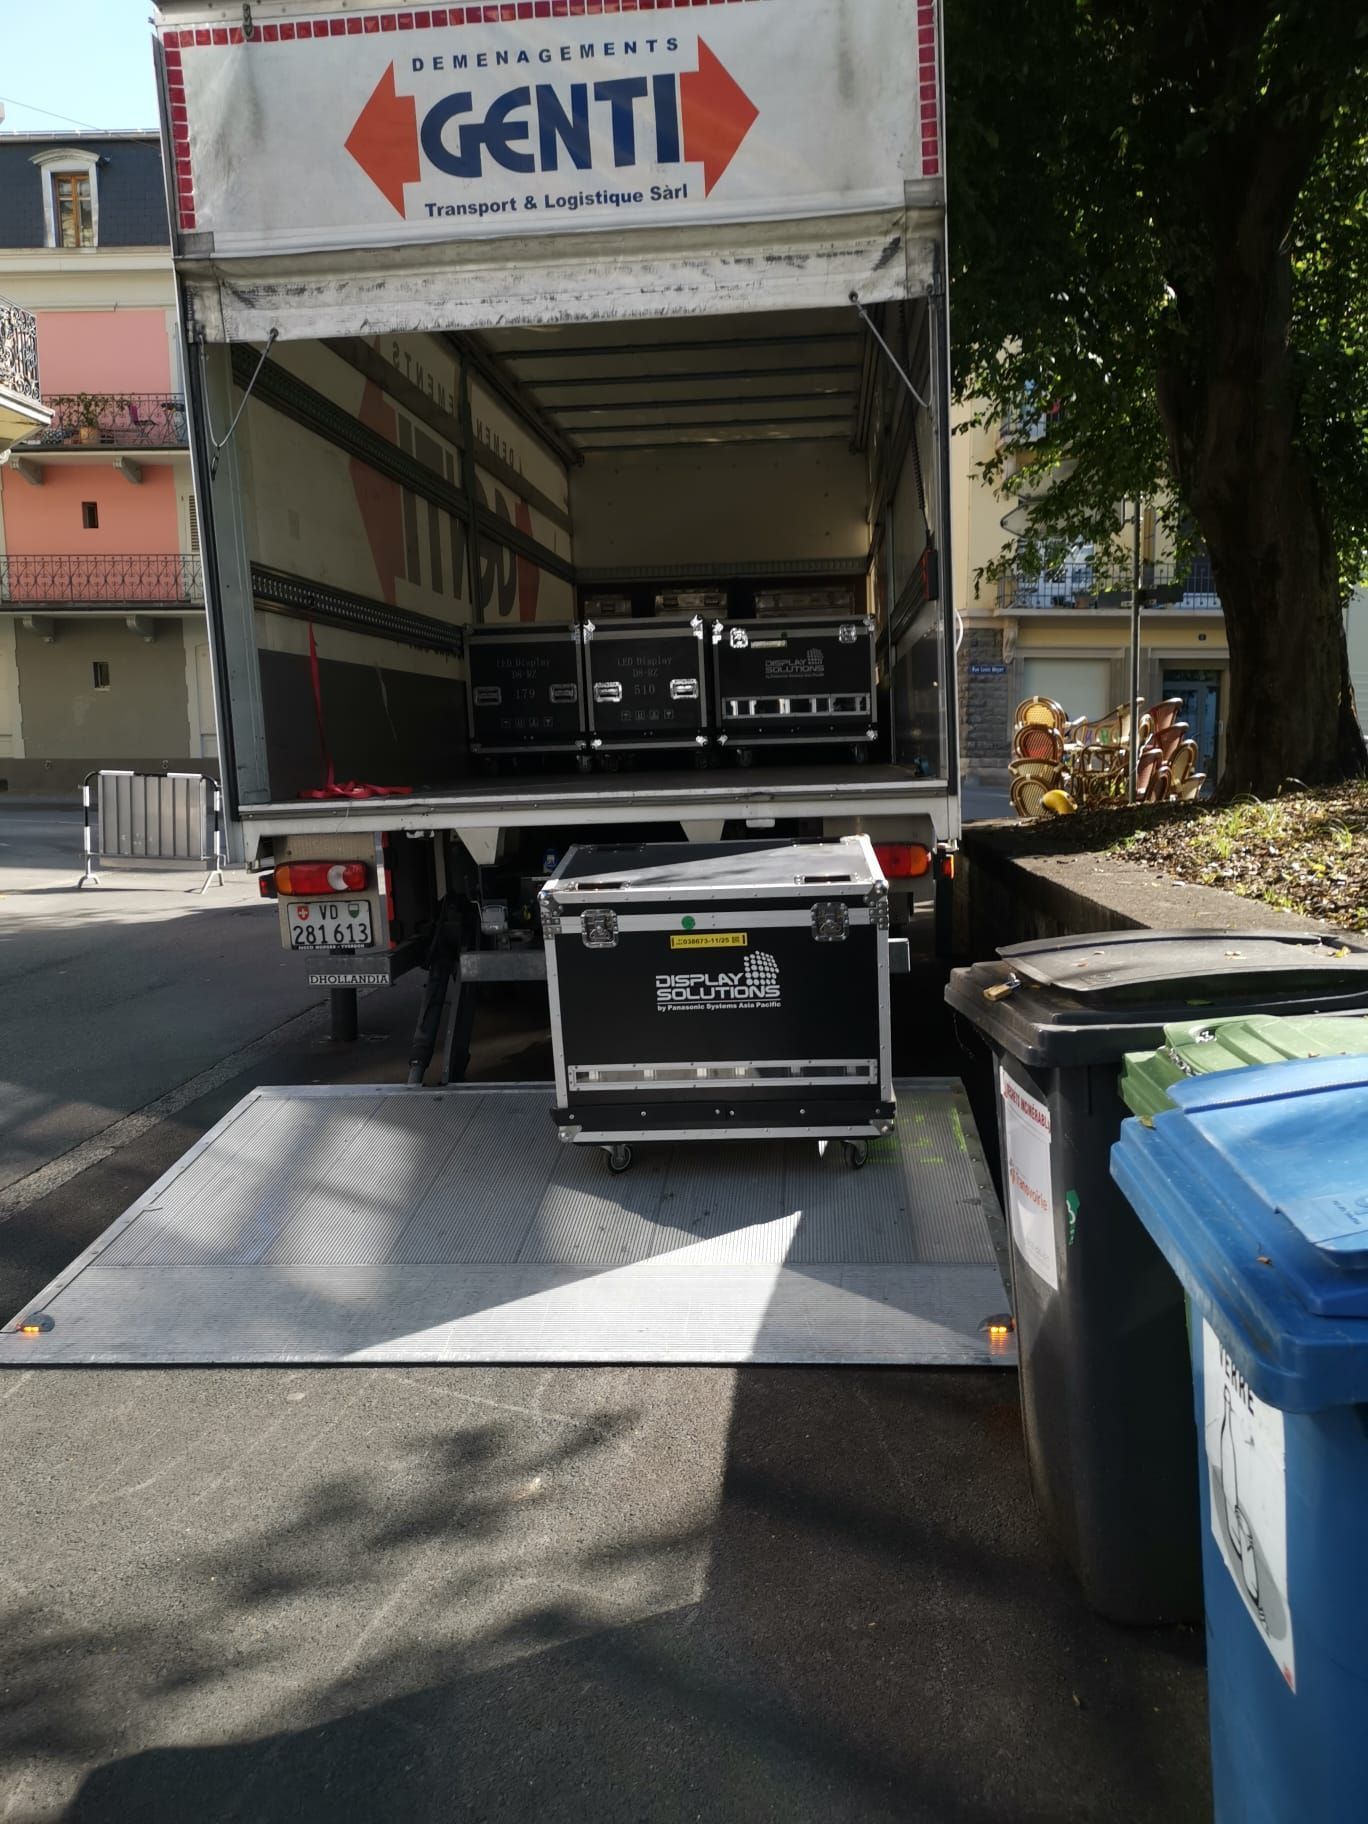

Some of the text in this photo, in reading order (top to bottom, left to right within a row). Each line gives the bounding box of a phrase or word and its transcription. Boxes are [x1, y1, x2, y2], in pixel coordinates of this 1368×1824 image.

[412, 37, 679, 73] DEMENAGEMENTS
[420, 73, 680, 178] GENTI
[425, 183, 688, 218] Transport & Logistique Sàrl
[765, 658, 807, 667] DISPLAY
[765, 665, 825, 674] SOLUTIONS
[634, 683, 656, 696] 510
[319, 904, 338, 920] VD
[310, 974, 388, 985] DHOLLANDIA
[655, 972, 744, 988] DISPLAY
[656, 985, 781, 1001] SOLUTIONS
[657, 1004, 667, 1012] by
[667, 1003, 705, 1011] Panasonic
[706, 1002, 738, 1011] Systems
[755, 1001, 782, 1009] Pacific
